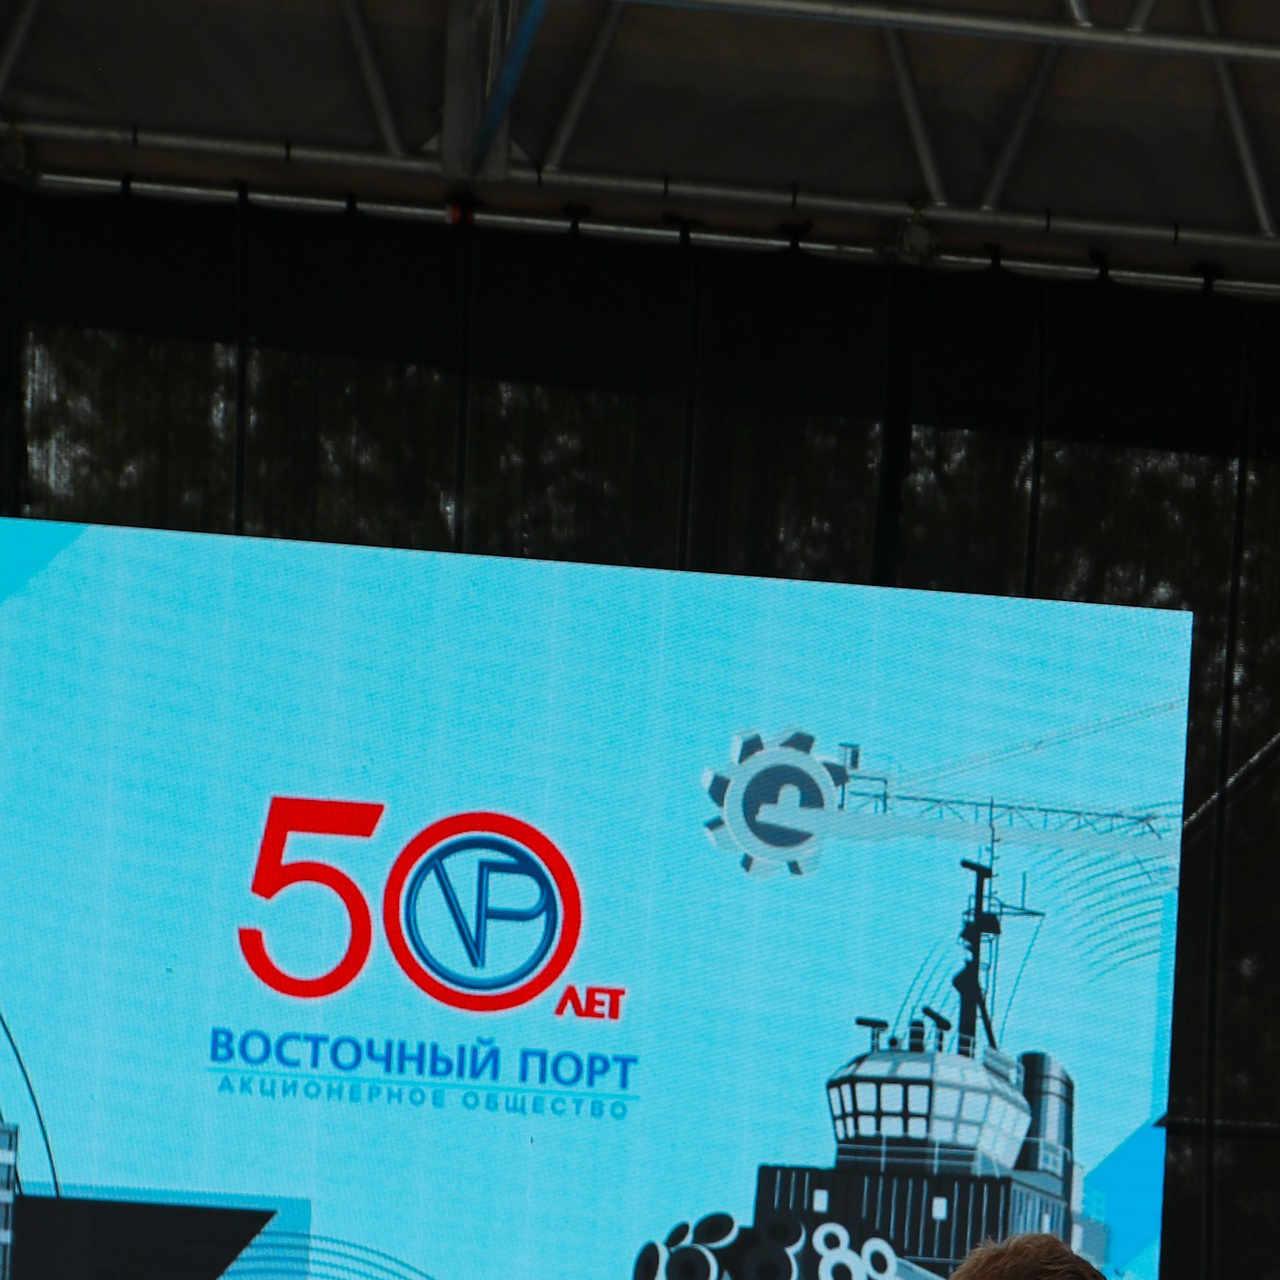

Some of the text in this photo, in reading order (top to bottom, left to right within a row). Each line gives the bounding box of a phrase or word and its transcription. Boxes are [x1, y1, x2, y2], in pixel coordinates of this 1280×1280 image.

[238, 796, 626, 1020] 50 ЛЕТ
[209, 1026, 640, 1091] ВОСТОЧНЫЙ ПОРТ
[217, 1074, 629, 1122] АКЦИОНЕРНОЕ ОБЩЕСТВО
